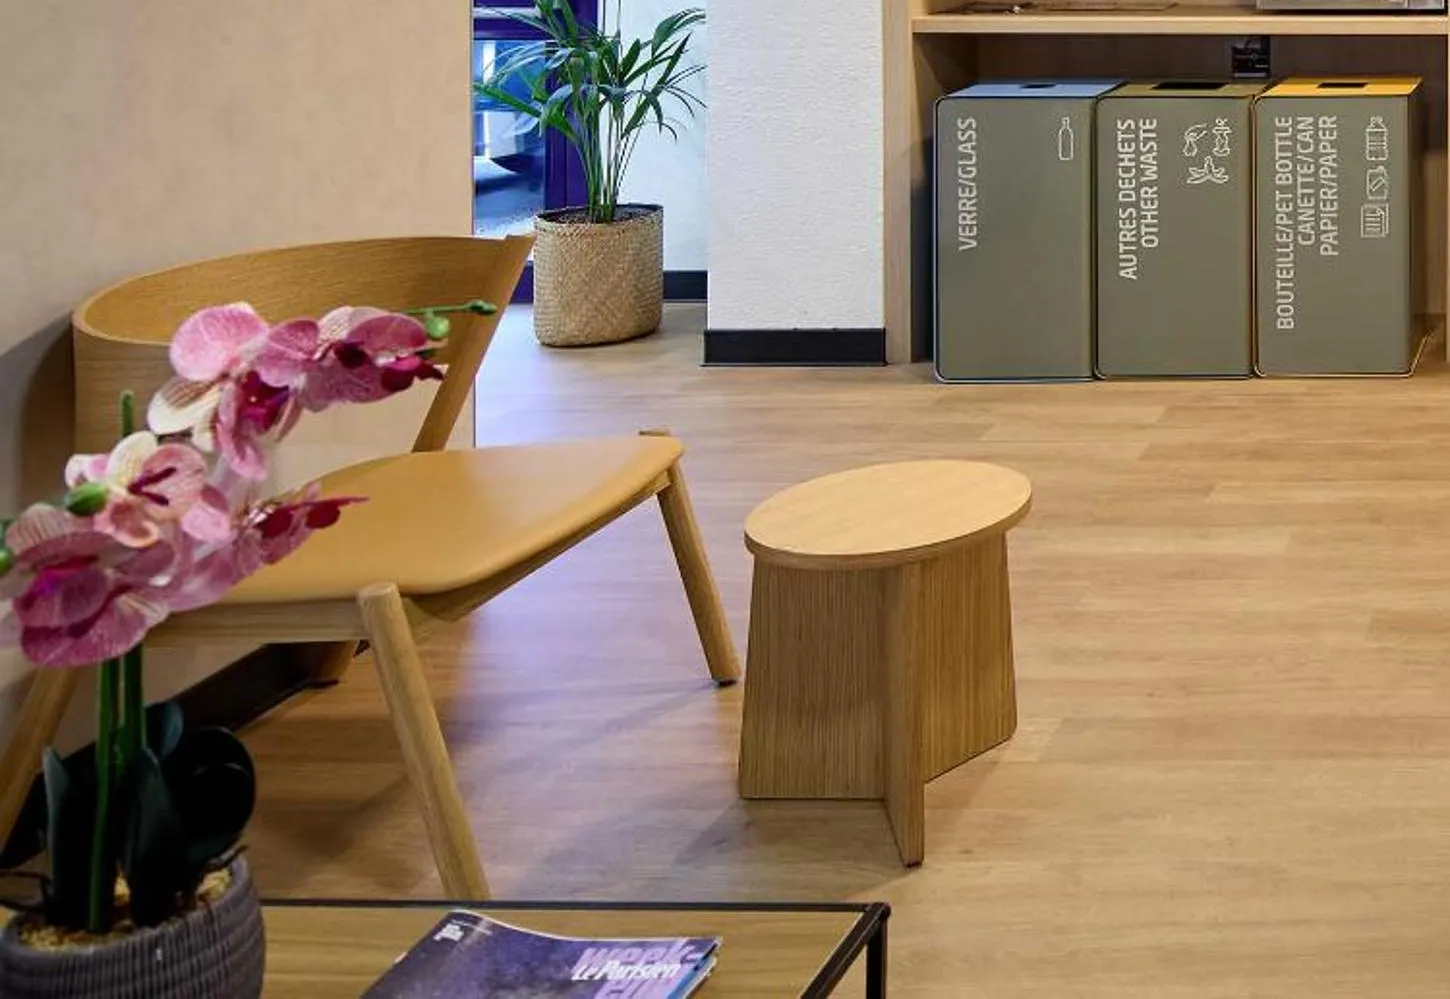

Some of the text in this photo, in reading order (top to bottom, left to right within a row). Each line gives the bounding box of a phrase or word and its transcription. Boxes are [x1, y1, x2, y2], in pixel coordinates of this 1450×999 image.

[956, 117, 977, 251] VERRE/GLASS
[1117, 118, 1137, 280] AUTRES DECHETS
[1139, 118, 1159, 248] OTHER WASTE
[1275, 116, 1295, 330] BOUTEILLE/PET BOTTLE
[1296, 116, 1315, 246] CANETTE/CAN
[1318, 115, 1338, 256] PAPIER/PAPER
[571, 965, 598, 981] Le
